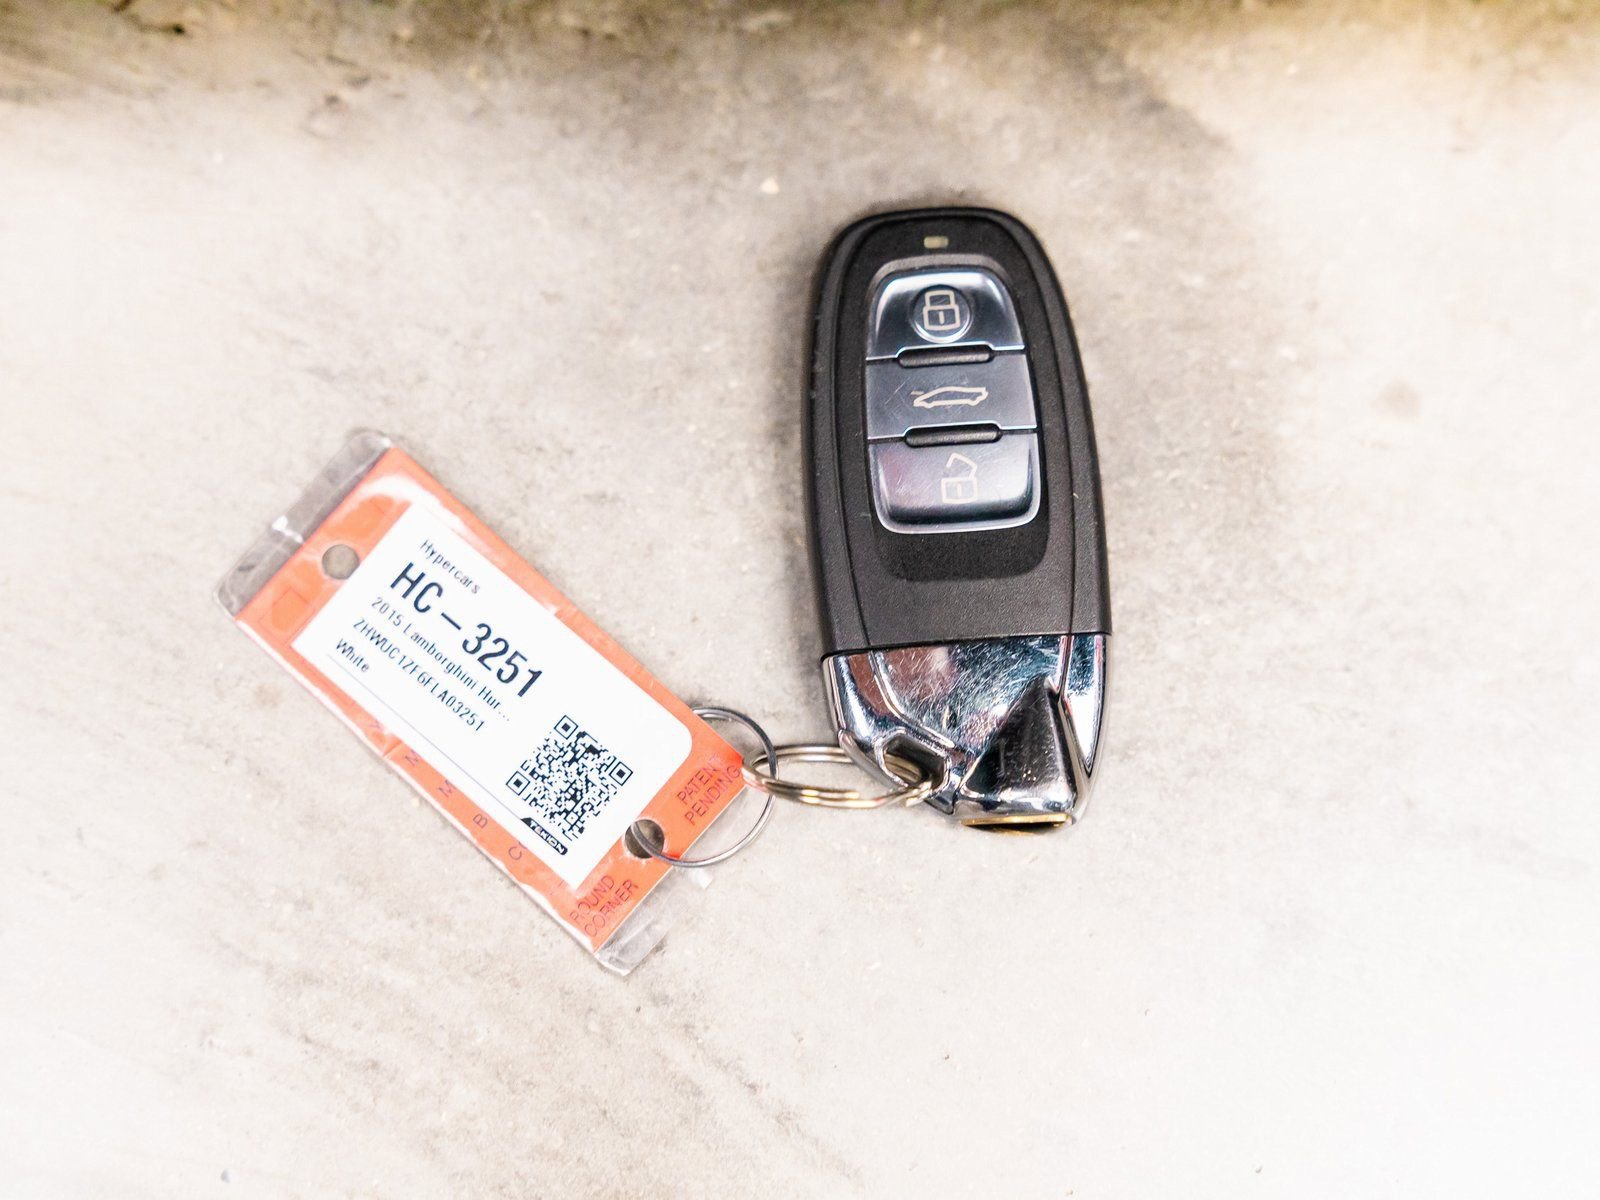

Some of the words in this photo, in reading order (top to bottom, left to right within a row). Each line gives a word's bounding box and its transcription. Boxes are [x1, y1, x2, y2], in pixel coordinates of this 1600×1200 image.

[420, 539, 481, 594] Hypercars
[335, 638, 370, 673] White
[371, 597, 404, 628] 2015
[403, 623, 479, 690] Lamborghini
[677, 753, 720, 805] PATENT
[684, 765, 741, 826] PENDING
[530, 820, 567, 855] TEKION
[569, 875, 615, 923] ROUND
[584, 879, 639, 937] CORNER
